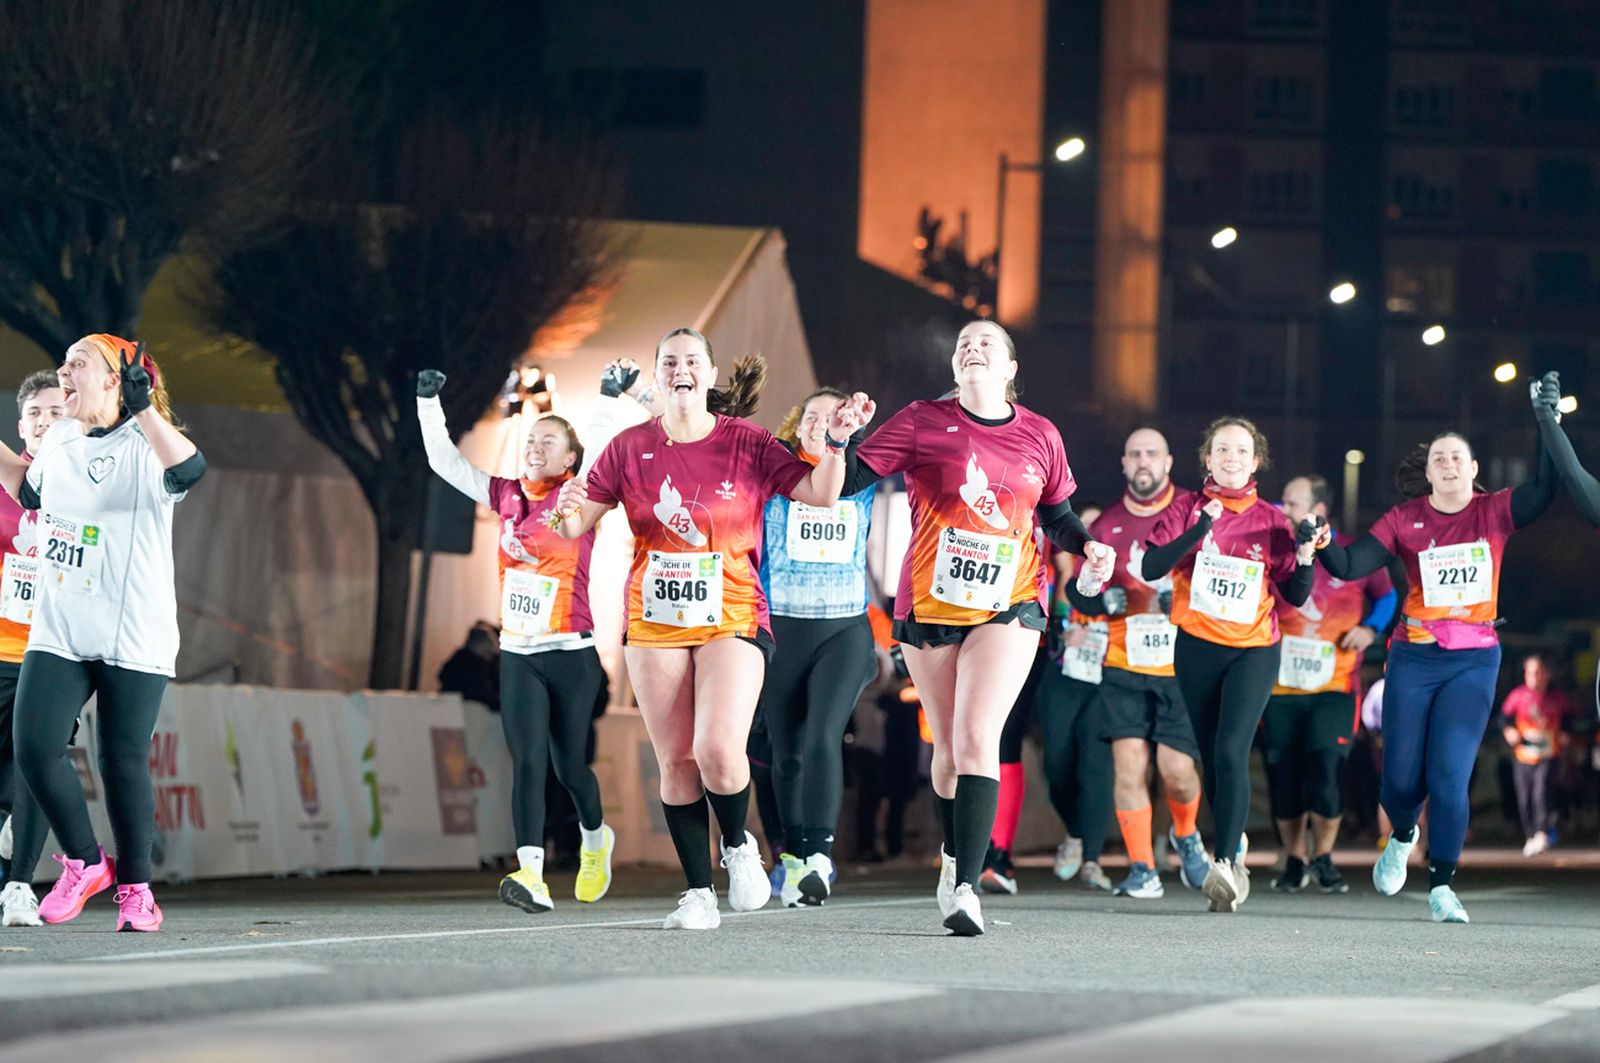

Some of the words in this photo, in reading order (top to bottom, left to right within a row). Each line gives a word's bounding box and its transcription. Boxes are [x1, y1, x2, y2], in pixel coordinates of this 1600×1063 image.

[974, 495, 995, 516] 43
[669, 513, 690, 533] 43
[800, 522, 846, 541] 6909
[26, 546, 39, 558] 4
[45, 538, 84, 568] 2311
[946, 545, 961, 555] SAN
[956, 538, 979, 550] NOCHE
[980, 543, 990, 552] DE
[682, 561, 692, 569] DE
[949, 556, 1001, 586] 3647
[1438, 566, 1478, 586] 2212
[654, 578, 708, 602] 3646
[1206, 577, 1247, 600] 4512
[509, 593, 541, 615] 6739
[1142, 633, 1170, 648] 484
[1292, 657, 1323, 673] 1700
